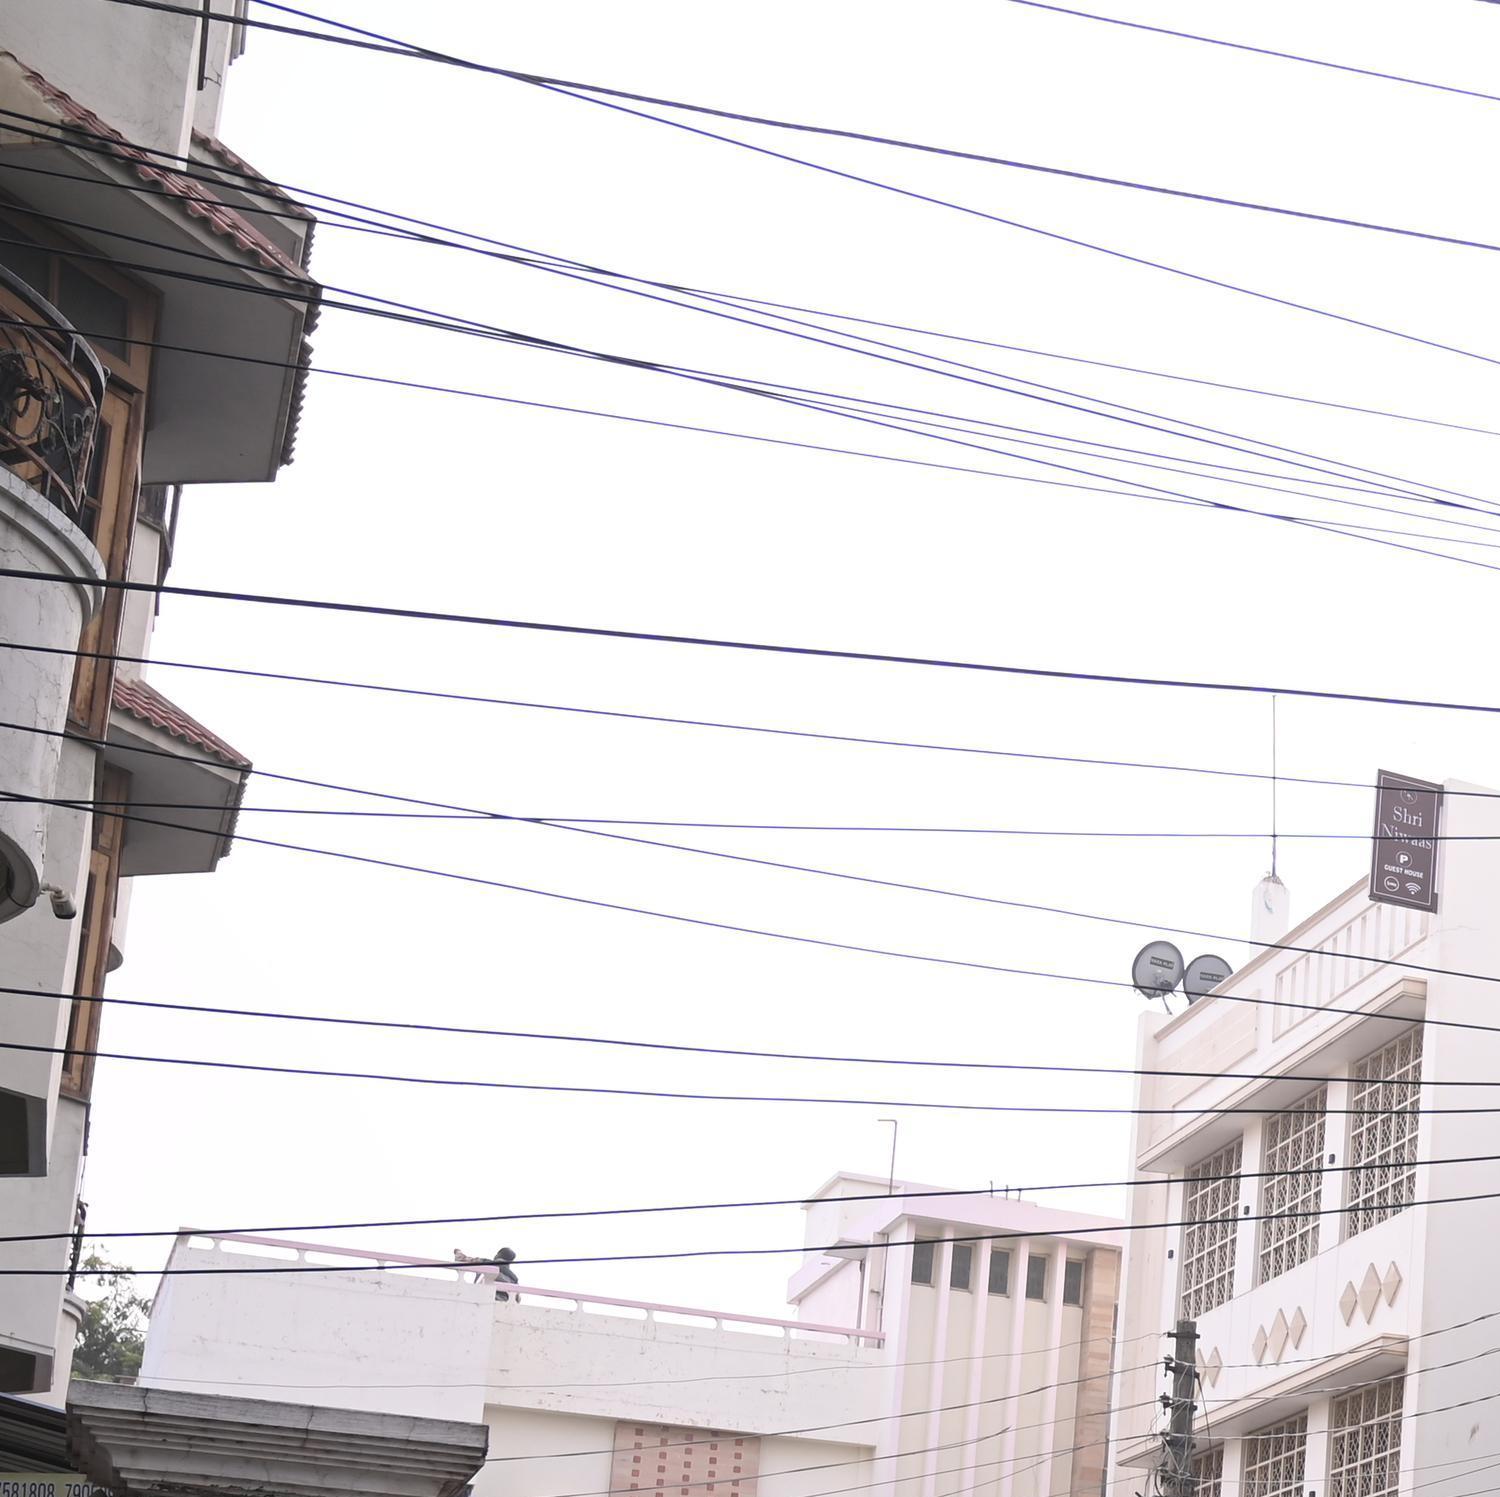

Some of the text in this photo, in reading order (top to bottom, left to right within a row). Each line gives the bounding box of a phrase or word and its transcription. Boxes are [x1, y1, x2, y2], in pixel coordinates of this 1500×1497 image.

[1393, 806, 1422, 827] Shri
[1382, 823, 1432, 849] Niwaas
[1384, 864, 1424, 879] GUEST HOUSE
